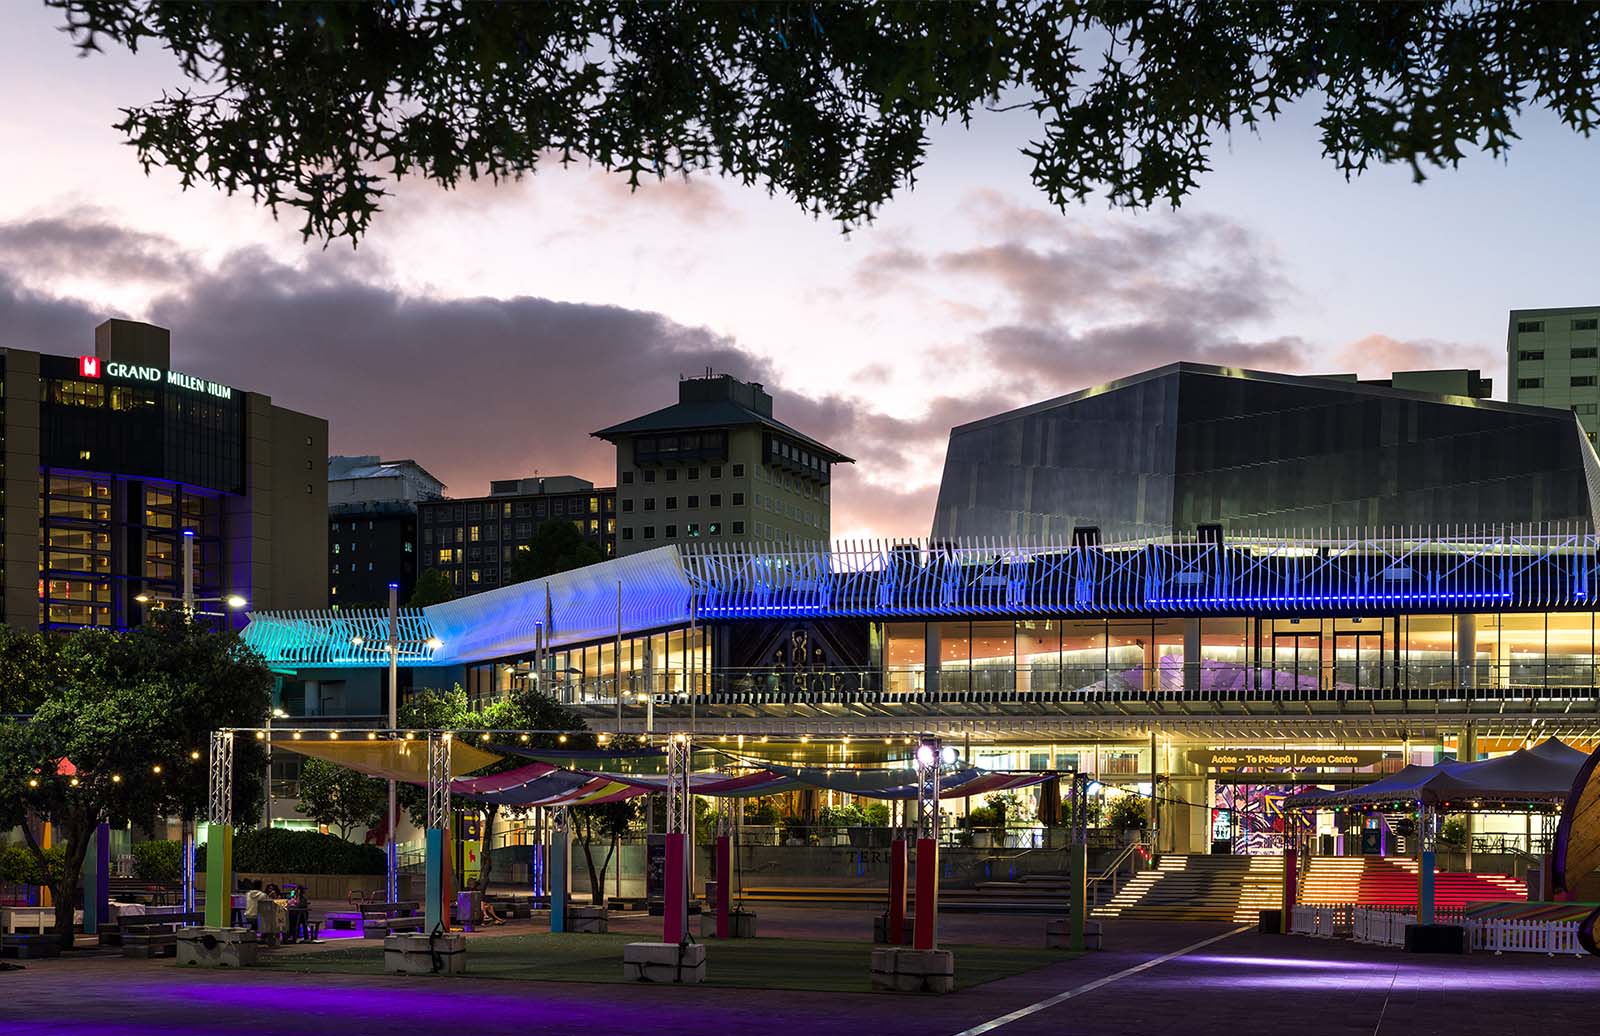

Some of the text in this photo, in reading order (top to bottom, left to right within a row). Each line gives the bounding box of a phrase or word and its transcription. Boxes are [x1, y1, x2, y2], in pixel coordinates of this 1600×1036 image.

[107, 362, 161, 382] GRAND
[167, 370, 231, 400] MILLENNIUM
[1211, 754, 1238, 764] Aotea
[1245, 754, 1258, 764] Te
[1300, 754, 1327, 764] Aotea
[1327, 754, 1358, 764] Centre
